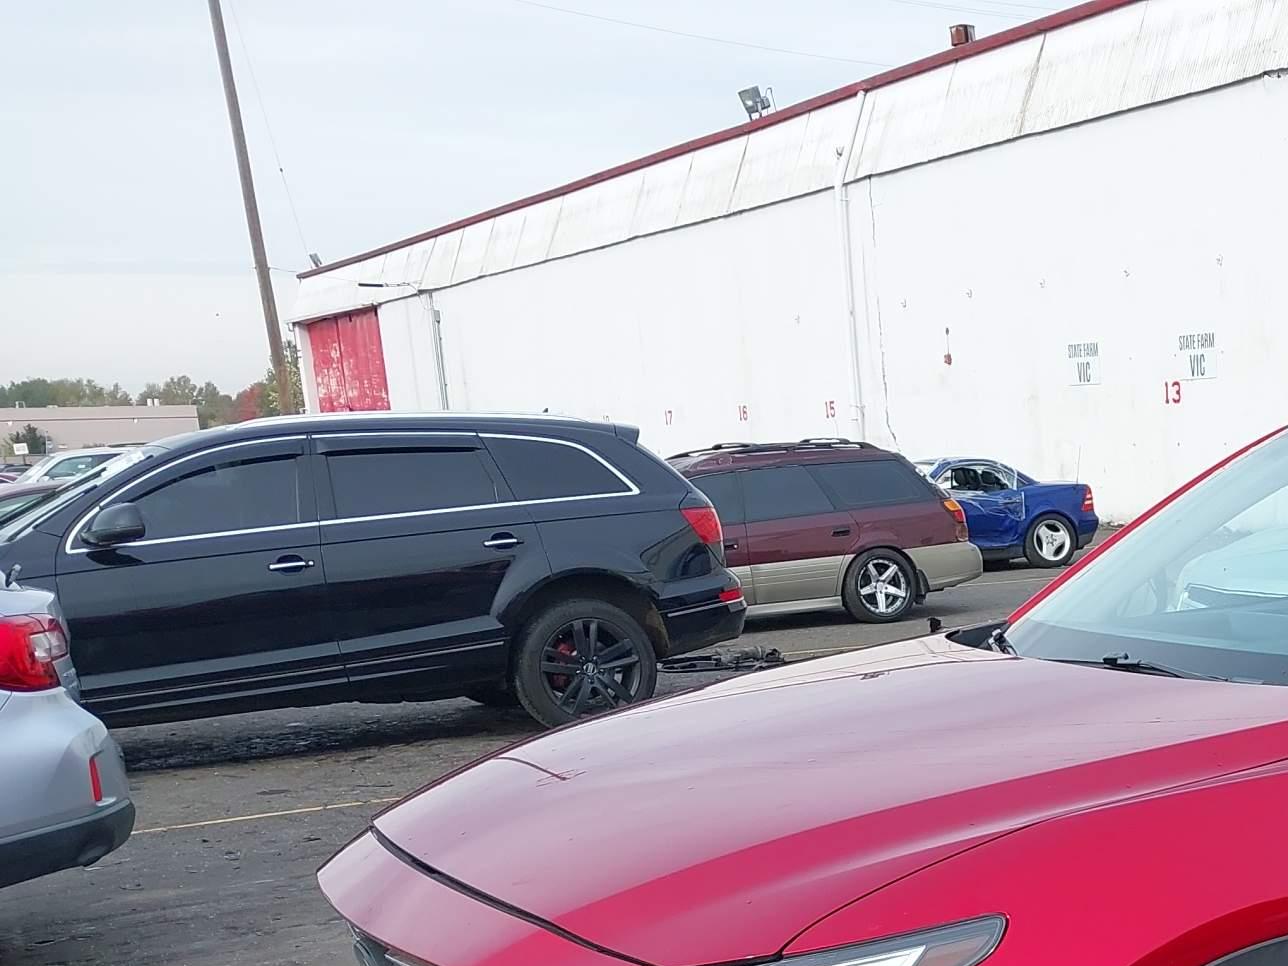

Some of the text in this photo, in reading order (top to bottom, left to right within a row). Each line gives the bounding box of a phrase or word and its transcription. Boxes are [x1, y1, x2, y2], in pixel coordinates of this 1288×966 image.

[1179, 332, 1215, 351] STATE FARM
[1077, 362, 1091, 383] VIC
[1189, 354, 1206, 377] VIC
[1165, 381, 1181, 404] 13
[664, 409, 672, 425] 17
[738, 405, 748, 421] 16
[825, 400, 836, 419] 15
